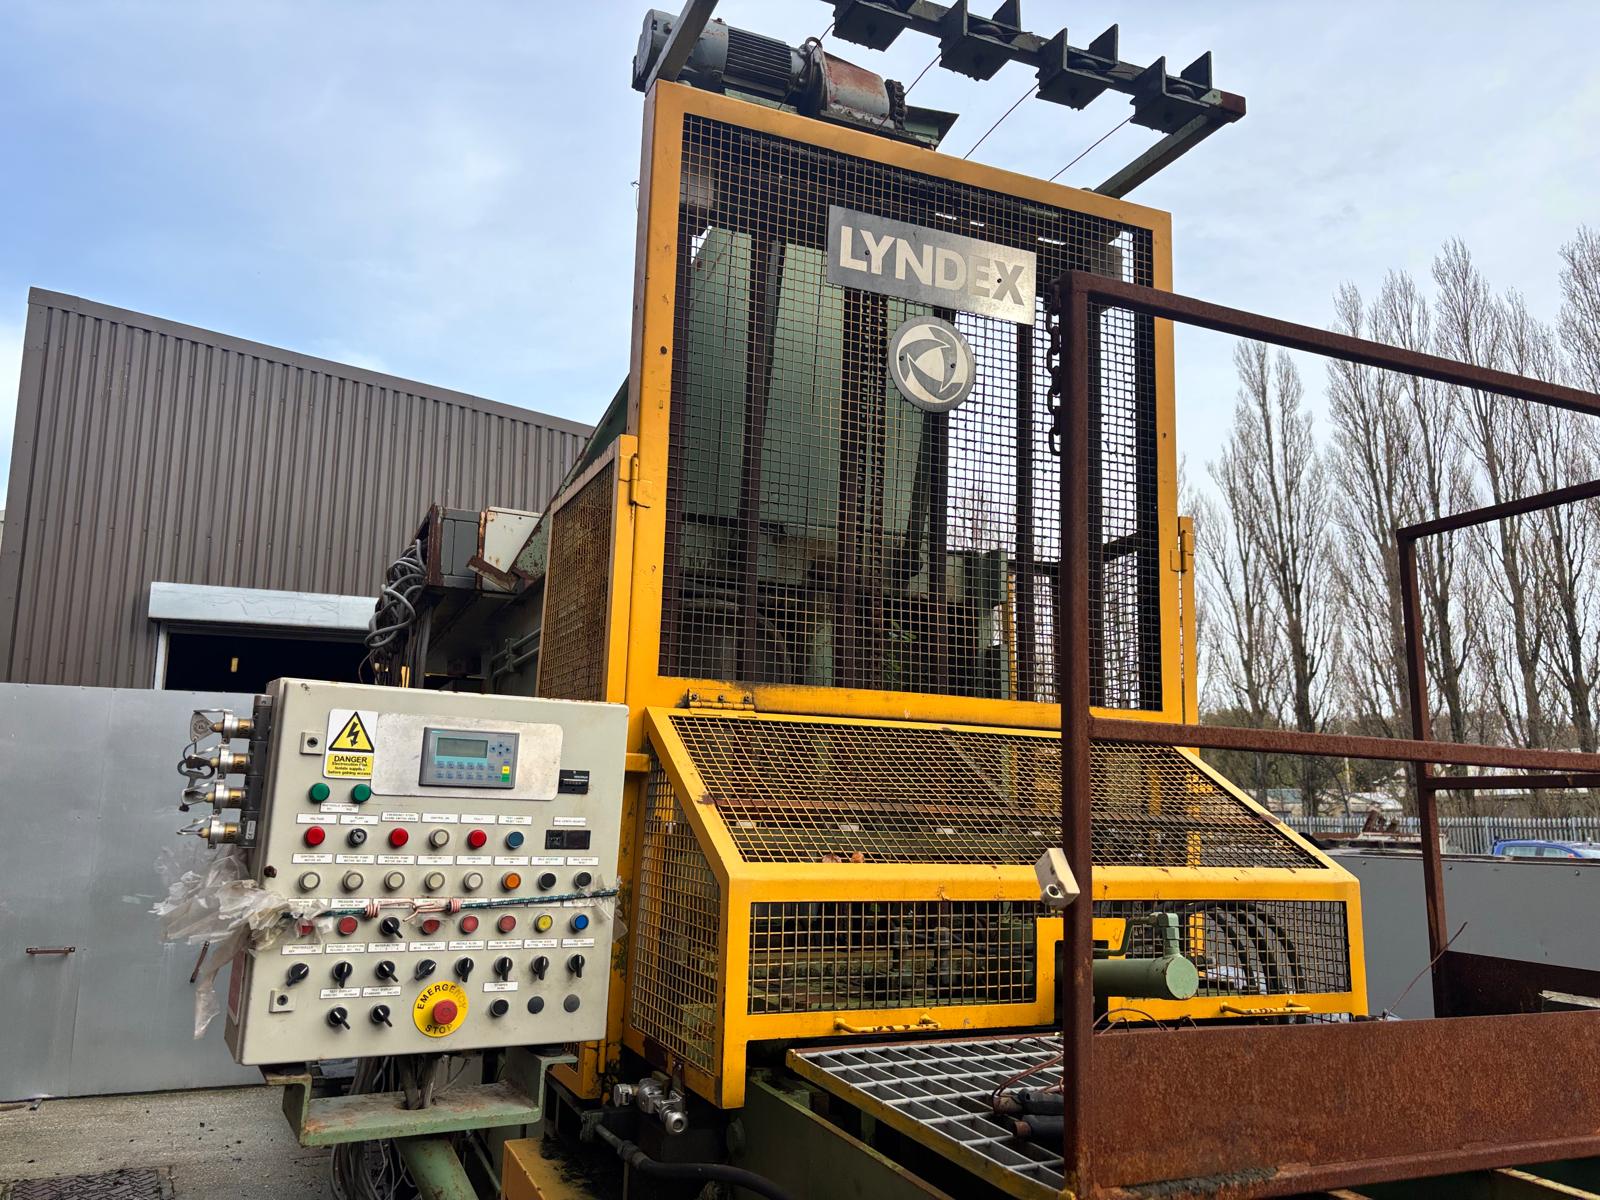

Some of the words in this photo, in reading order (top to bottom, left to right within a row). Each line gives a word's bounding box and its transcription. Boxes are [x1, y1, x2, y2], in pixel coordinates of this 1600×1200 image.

[839, 225, 1025, 306] LYNDEX
[334, 755, 368, 763] DANGER
[417, 983, 467, 1010] EMERGENCY
[425, 1023, 453, 1035] STOP
